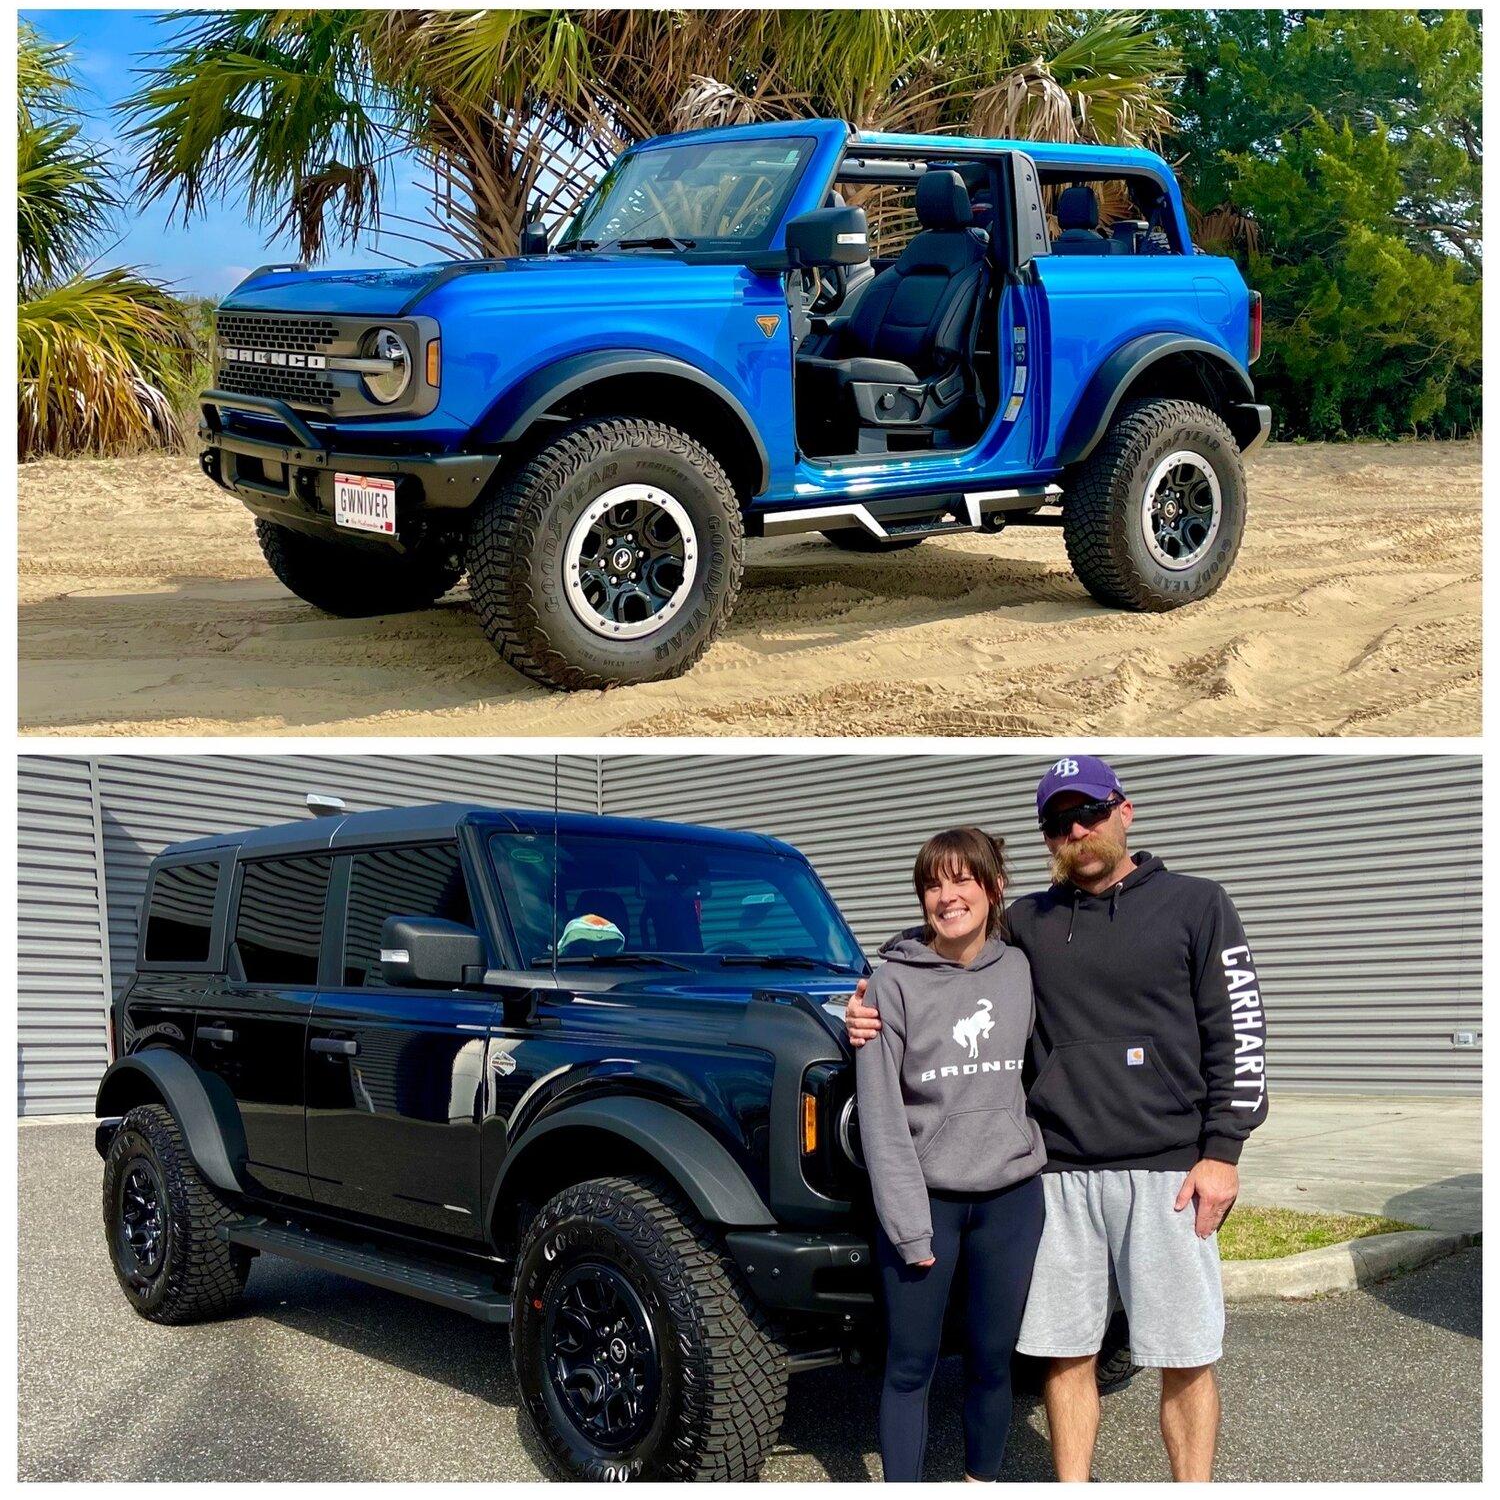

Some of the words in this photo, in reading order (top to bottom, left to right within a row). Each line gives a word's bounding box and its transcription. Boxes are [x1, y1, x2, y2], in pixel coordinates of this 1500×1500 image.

[225, 348, 326, 369] BRONCO
[340, 487, 389, 518] GWNIVER
[1051, 758, 1080, 778] TB
[1220, 945, 1265, 1112] CARHARTT
